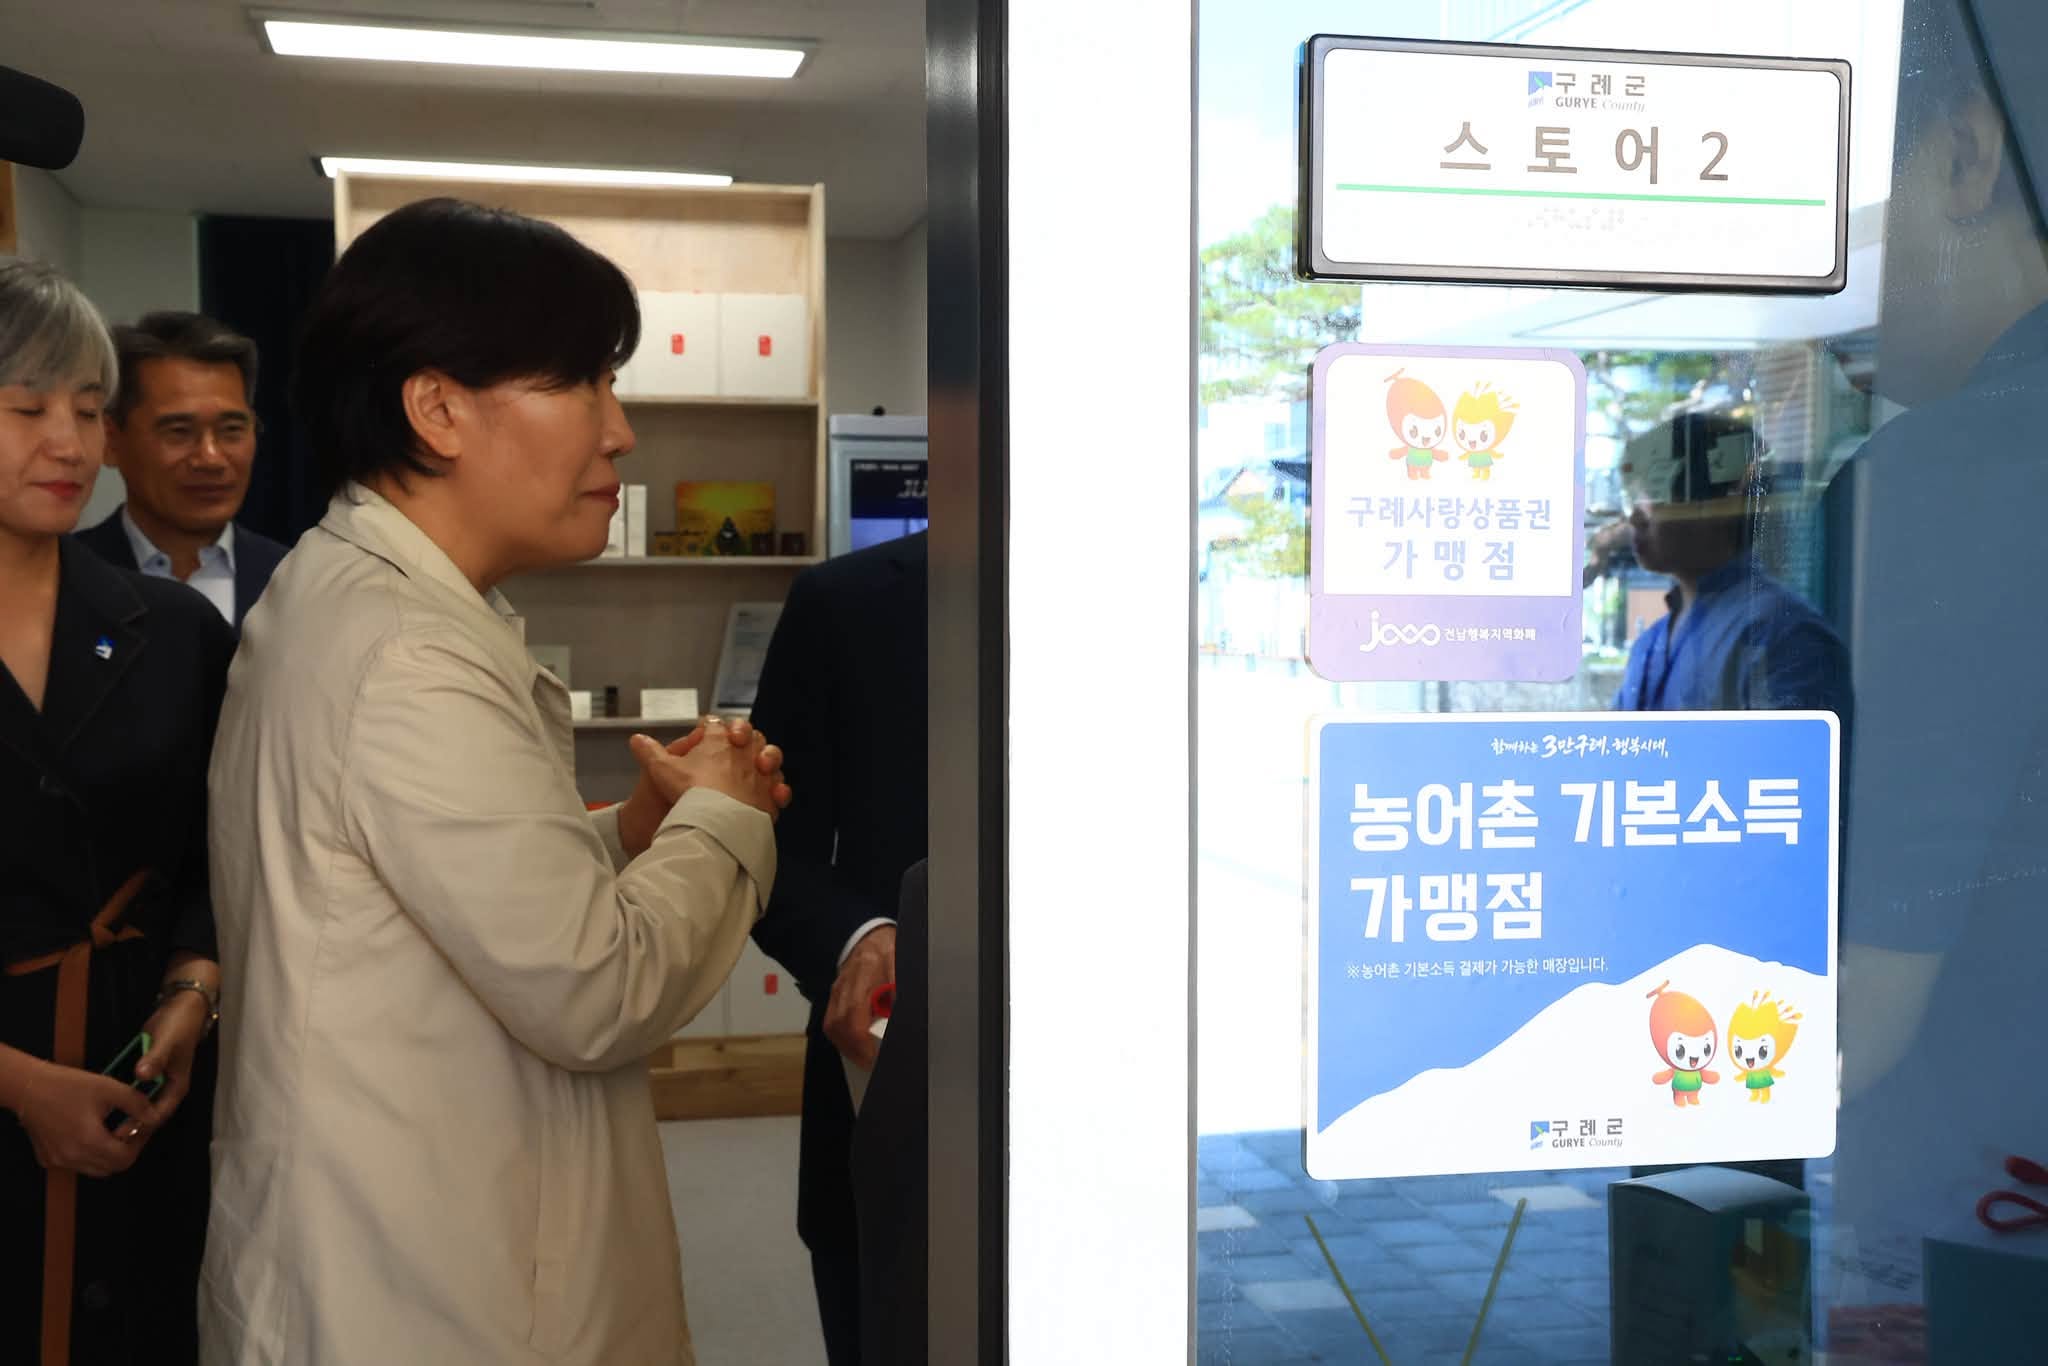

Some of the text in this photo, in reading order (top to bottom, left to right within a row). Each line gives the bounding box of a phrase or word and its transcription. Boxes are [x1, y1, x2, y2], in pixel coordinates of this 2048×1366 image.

[1555, 97, 1645, 113] GURYE County
[1439, 121, 1729, 185] 스토어 2
[1345, 496, 1553, 531] 구례사랑상품권
[1383, 540, 1515, 581] 가맹점
[1349, 778, 1803, 852] 농어촌 기본소득
[1349, 871, 1543, 943] 가맹점
[1403, 961, 1456, 977] 기본소득
[1459, 960, 1498, 977] 결제가
[1501, 958, 1539, 976] 가능한
[1542, 957, 1609, 974] 매장입니다.
[1551, 1137, 1624, 1149] GURYE County
